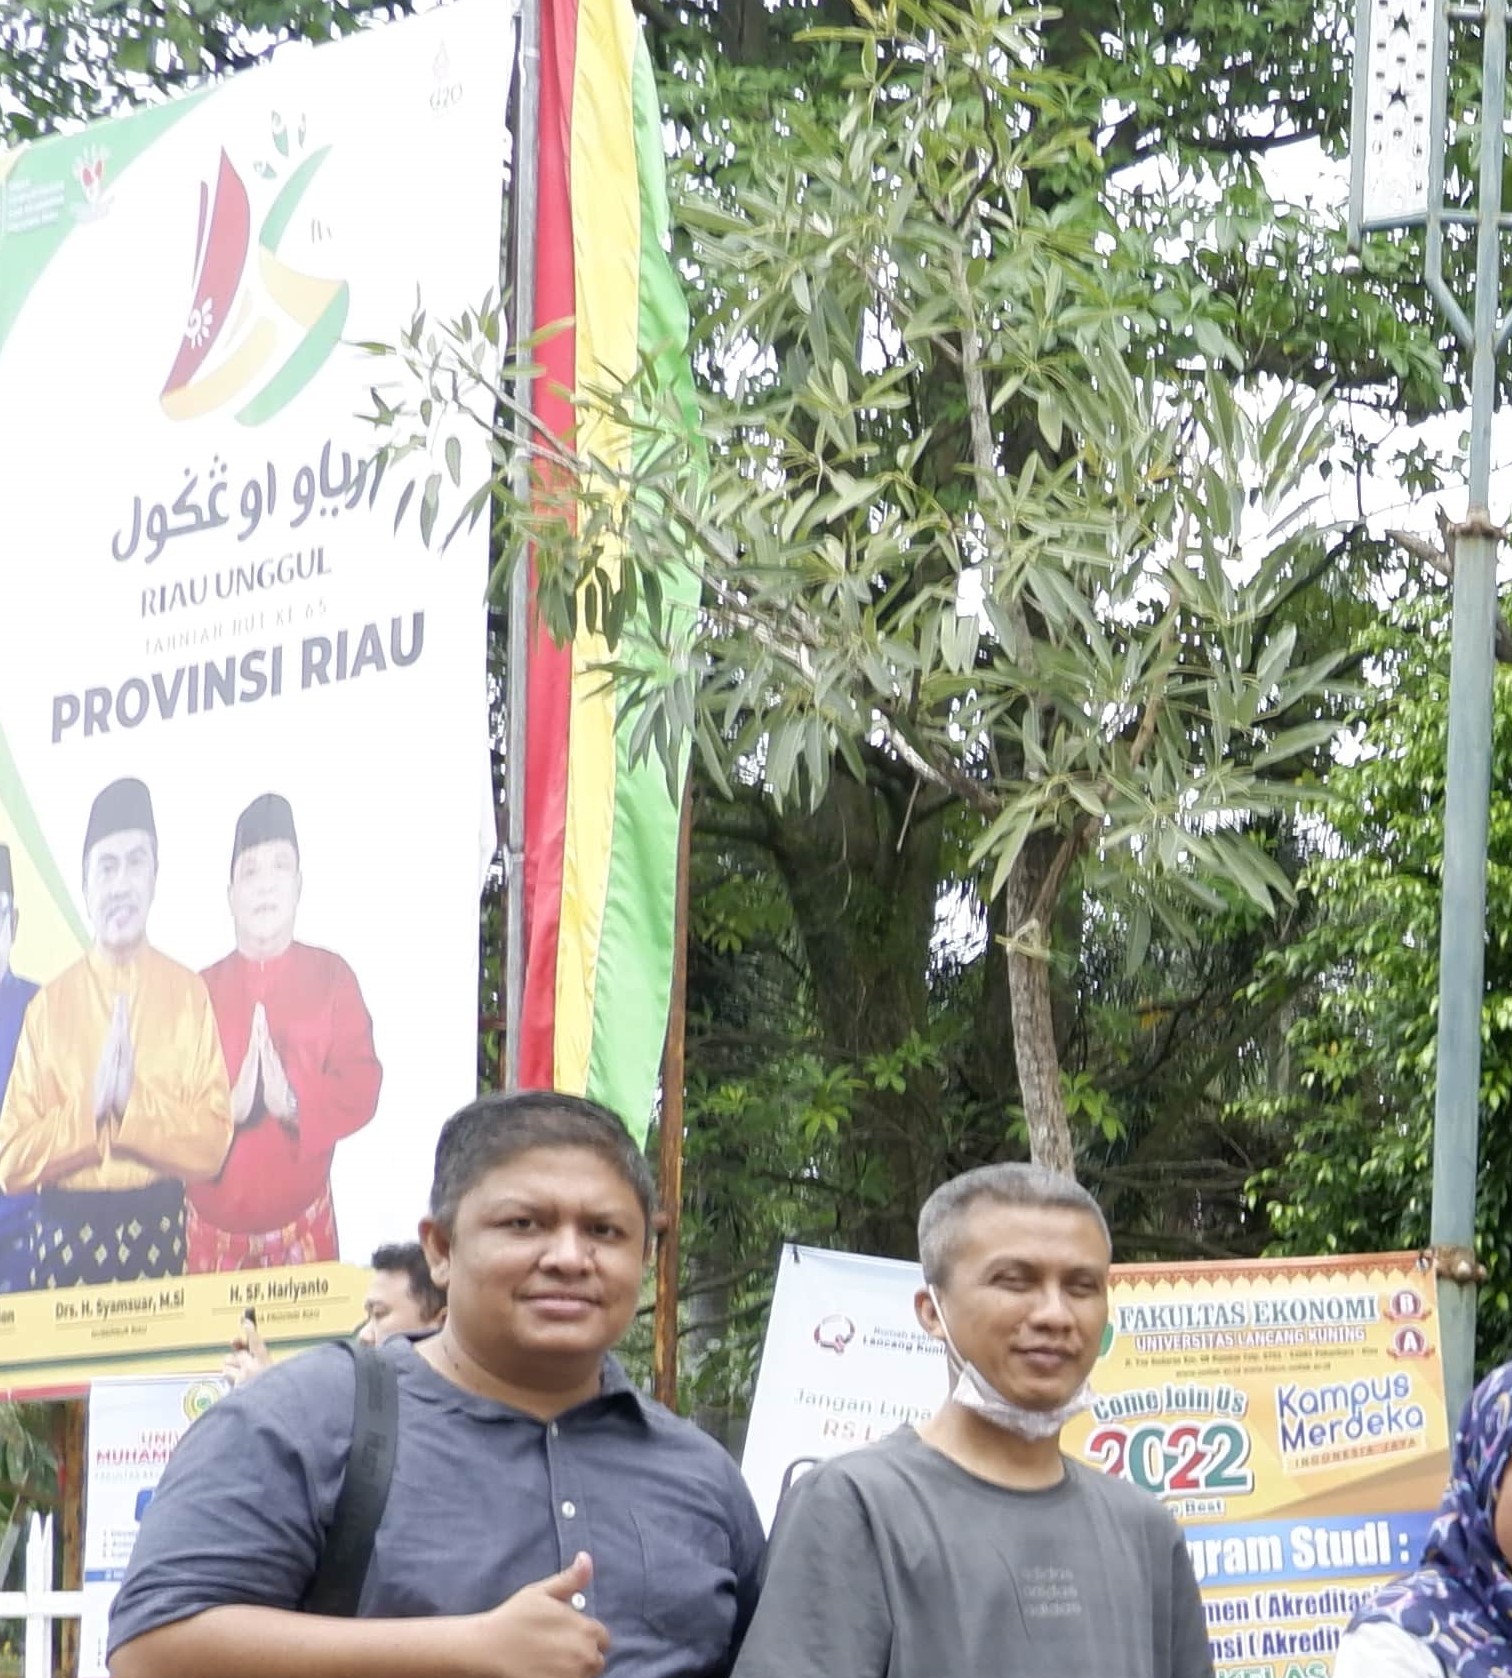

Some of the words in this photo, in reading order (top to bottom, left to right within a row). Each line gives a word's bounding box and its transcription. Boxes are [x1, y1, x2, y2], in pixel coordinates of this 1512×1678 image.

[141, 570, 209, 618] RIAU
[215, 547, 333, 599] UNGGUL
[51, 646, 283, 743] PROVINSI
[301, 611, 426, 689] RIAU
[56, 1301, 78, 1319] Drs.
[82, 1299, 95, 1317] H.
[96, 1294, 157, 1321] Syamsuar,
[229, 1283, 243, 1303] H.
[246, 1282, 265, 1302] SF.
[267, 1277, 329, 1303] Hariyanto
[1399, 1293, 1413, 1313] B
[1117, 1303, 1247, 1332] FAKULTAS
[1253, 1295, 1378, 1325] EKONOMI
[863, 1334, 913, 1351] Lancang
[1135, 1333, 1234, 1352] UNIVERSITAS
[1238, 1330, 1304, 1346] LANCANG
[1308, 1326, 1366, 1344] KUNING
[1402, 1331, 1416, 1352] A
[795, 1387, 872, 1413] Jangan
[879, 1399, 933, 1425] Lupa
[1093, 1390, 1159, 1421] Come
[1166, 1387, 1210, 1413] Join
[1216, 1389, 1248, 1415] Us
[1278, 1372, 1410, 1421] Kampus
[1280, 1402, 1424, 1452] Merdeka
[1089, 1424, 1250, 1490] 2022
[1290, 1521, 1392, 1570] Studi
